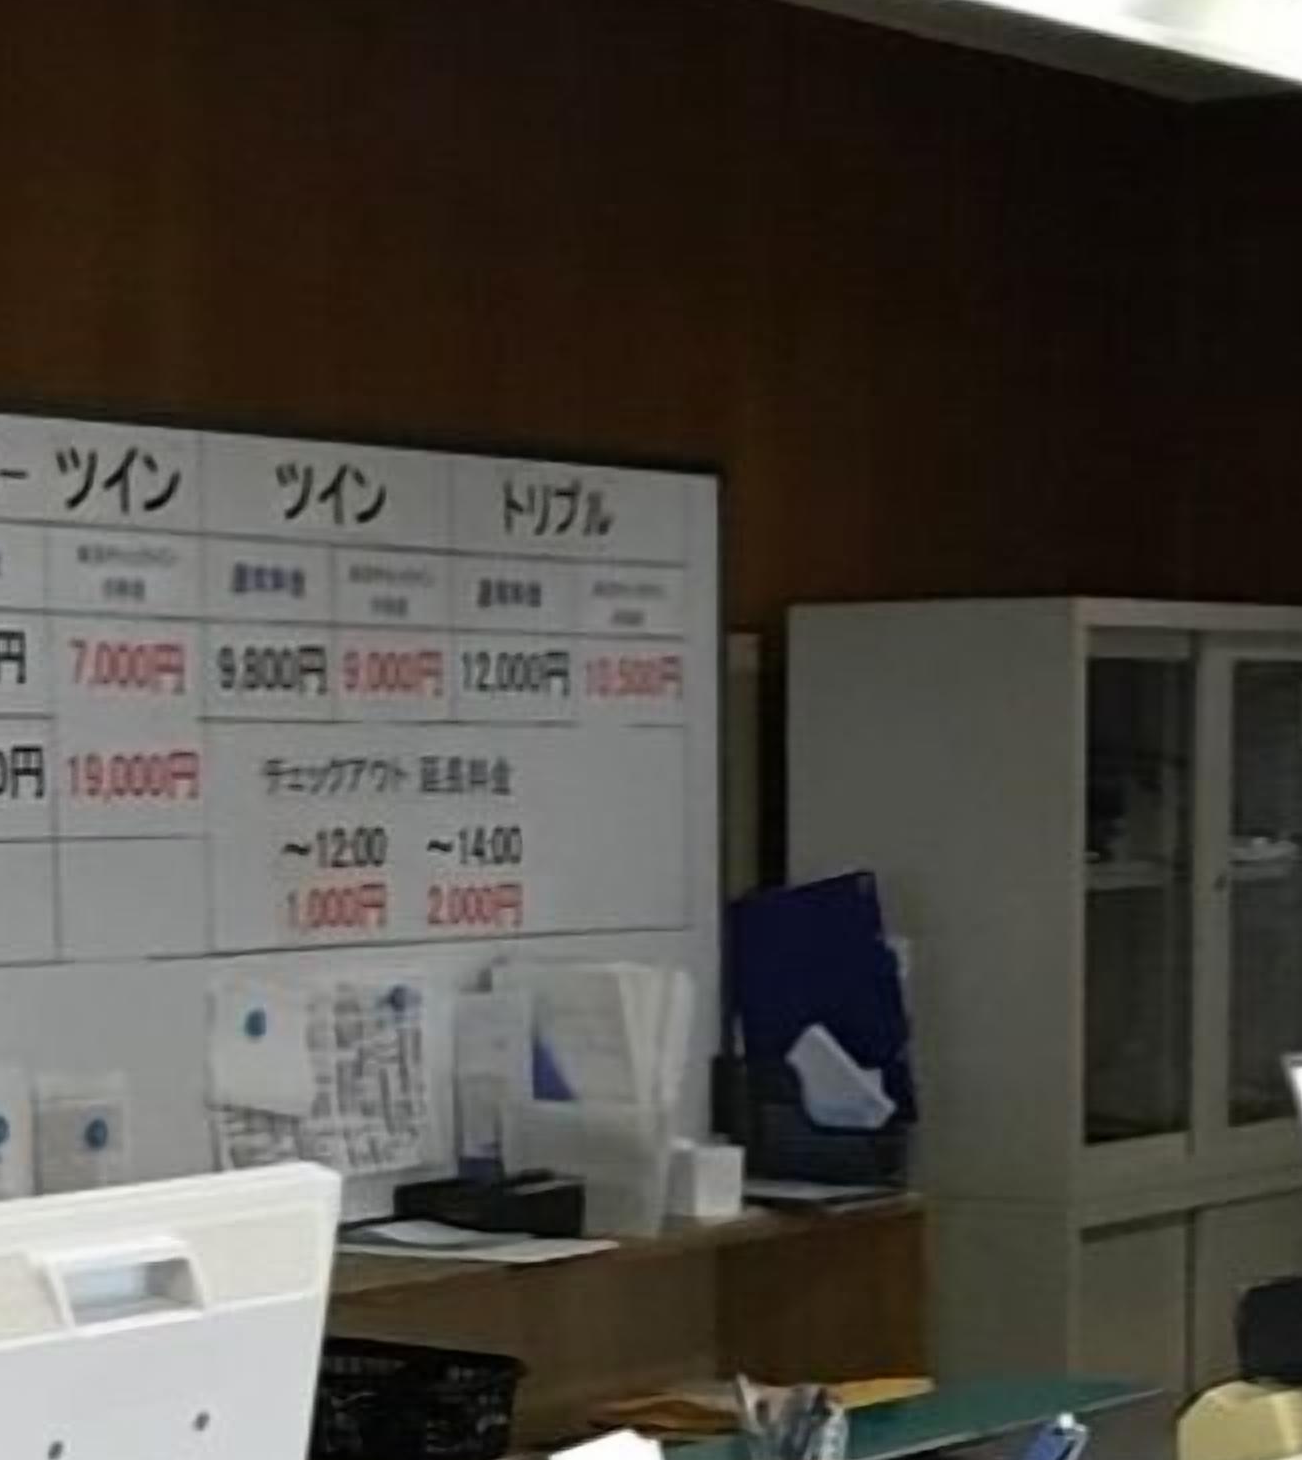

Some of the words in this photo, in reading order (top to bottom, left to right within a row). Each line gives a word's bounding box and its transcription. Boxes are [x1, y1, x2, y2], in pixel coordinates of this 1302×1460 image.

[55, 446, 182, 515] ツイン
[275, 462, 388, 525] ツイン
[70, 638, 185, 695] 7,000円
[461, 650, 571, 698] 12,000円
[67, 750, 198, 802] 19,000円
[427, 882, 524, 927] 2,000円
